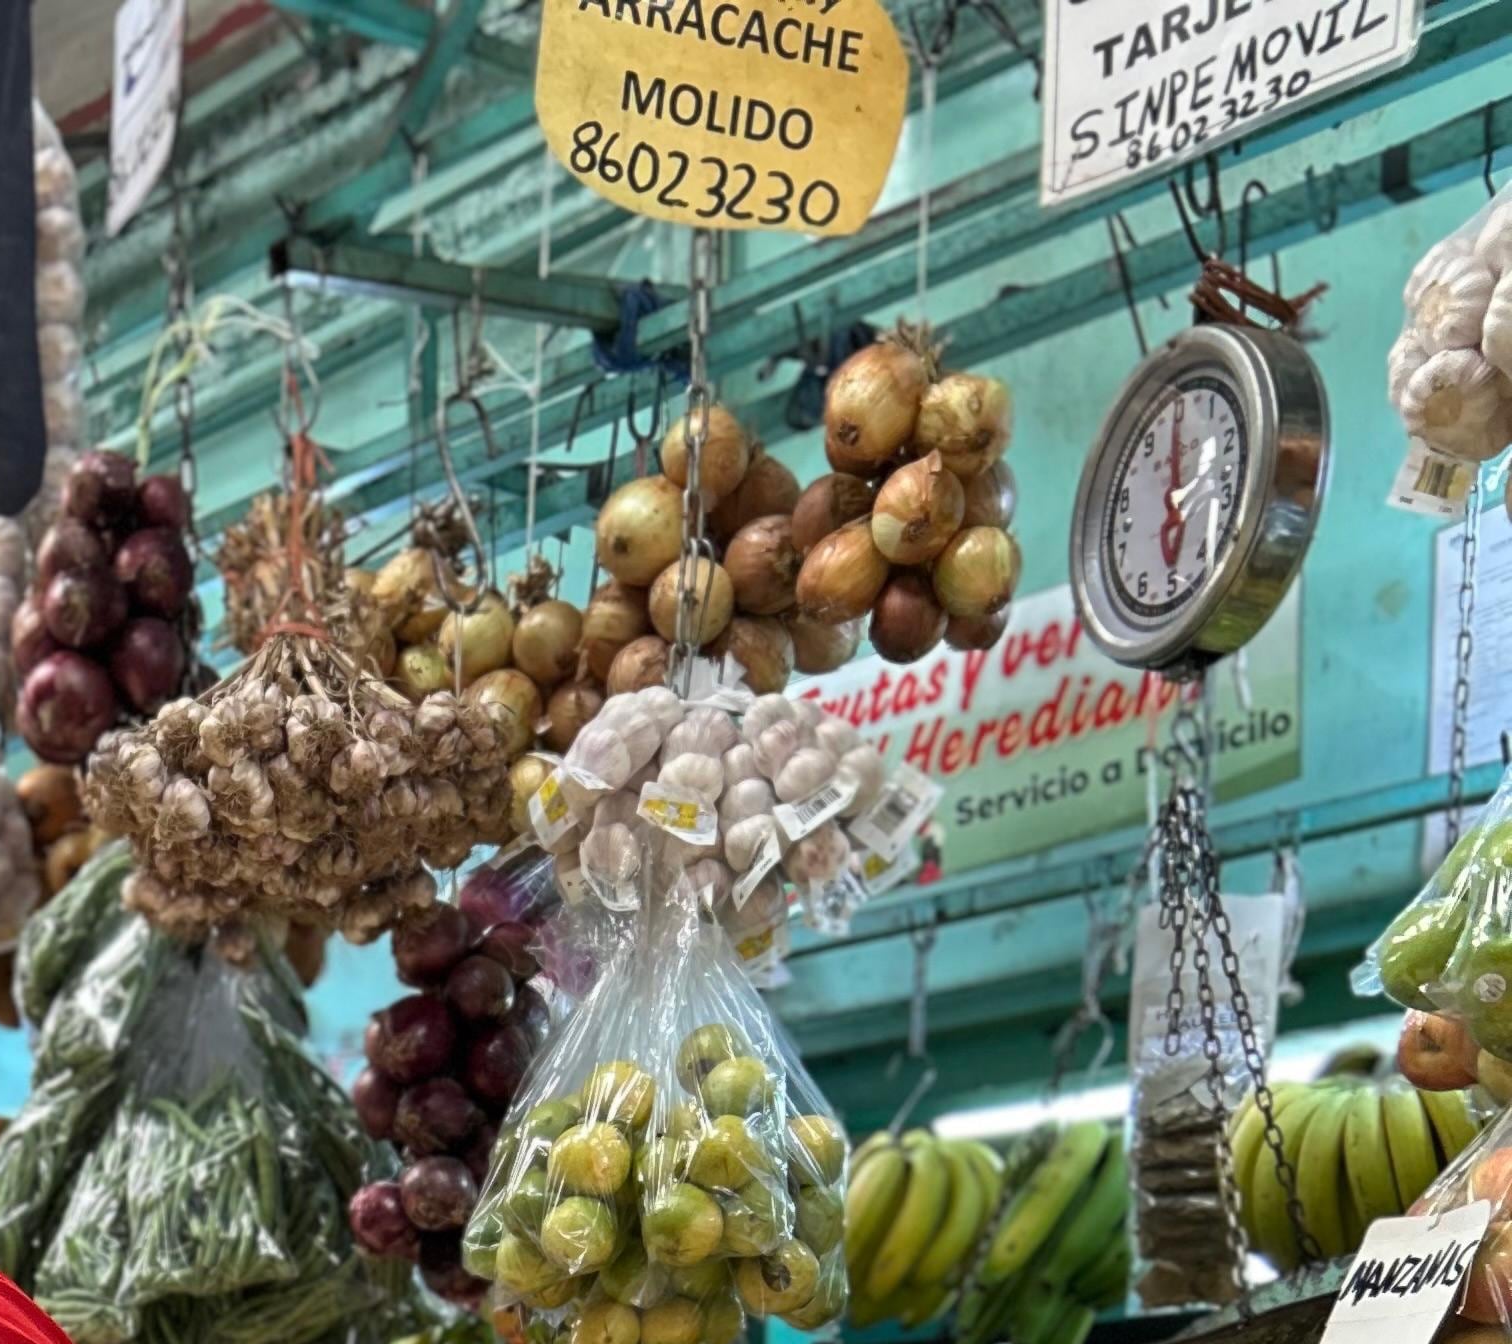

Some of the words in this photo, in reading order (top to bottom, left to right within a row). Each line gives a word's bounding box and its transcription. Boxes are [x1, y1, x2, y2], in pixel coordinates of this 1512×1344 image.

[621, 70, 813, 150] MOLIDO
[1071, 56, 1217, 160] SINPE
[570, 121, 840, 226] 86023230
[903, 673, 1203, 775] Heredian
[955, 762, 1090, 827] Servicio
[1101, 758, 1122, 784] a
[1135, 709, 1292, 774] Doicilo
[1339, 1239, 1480, 1306] MANZANAS
